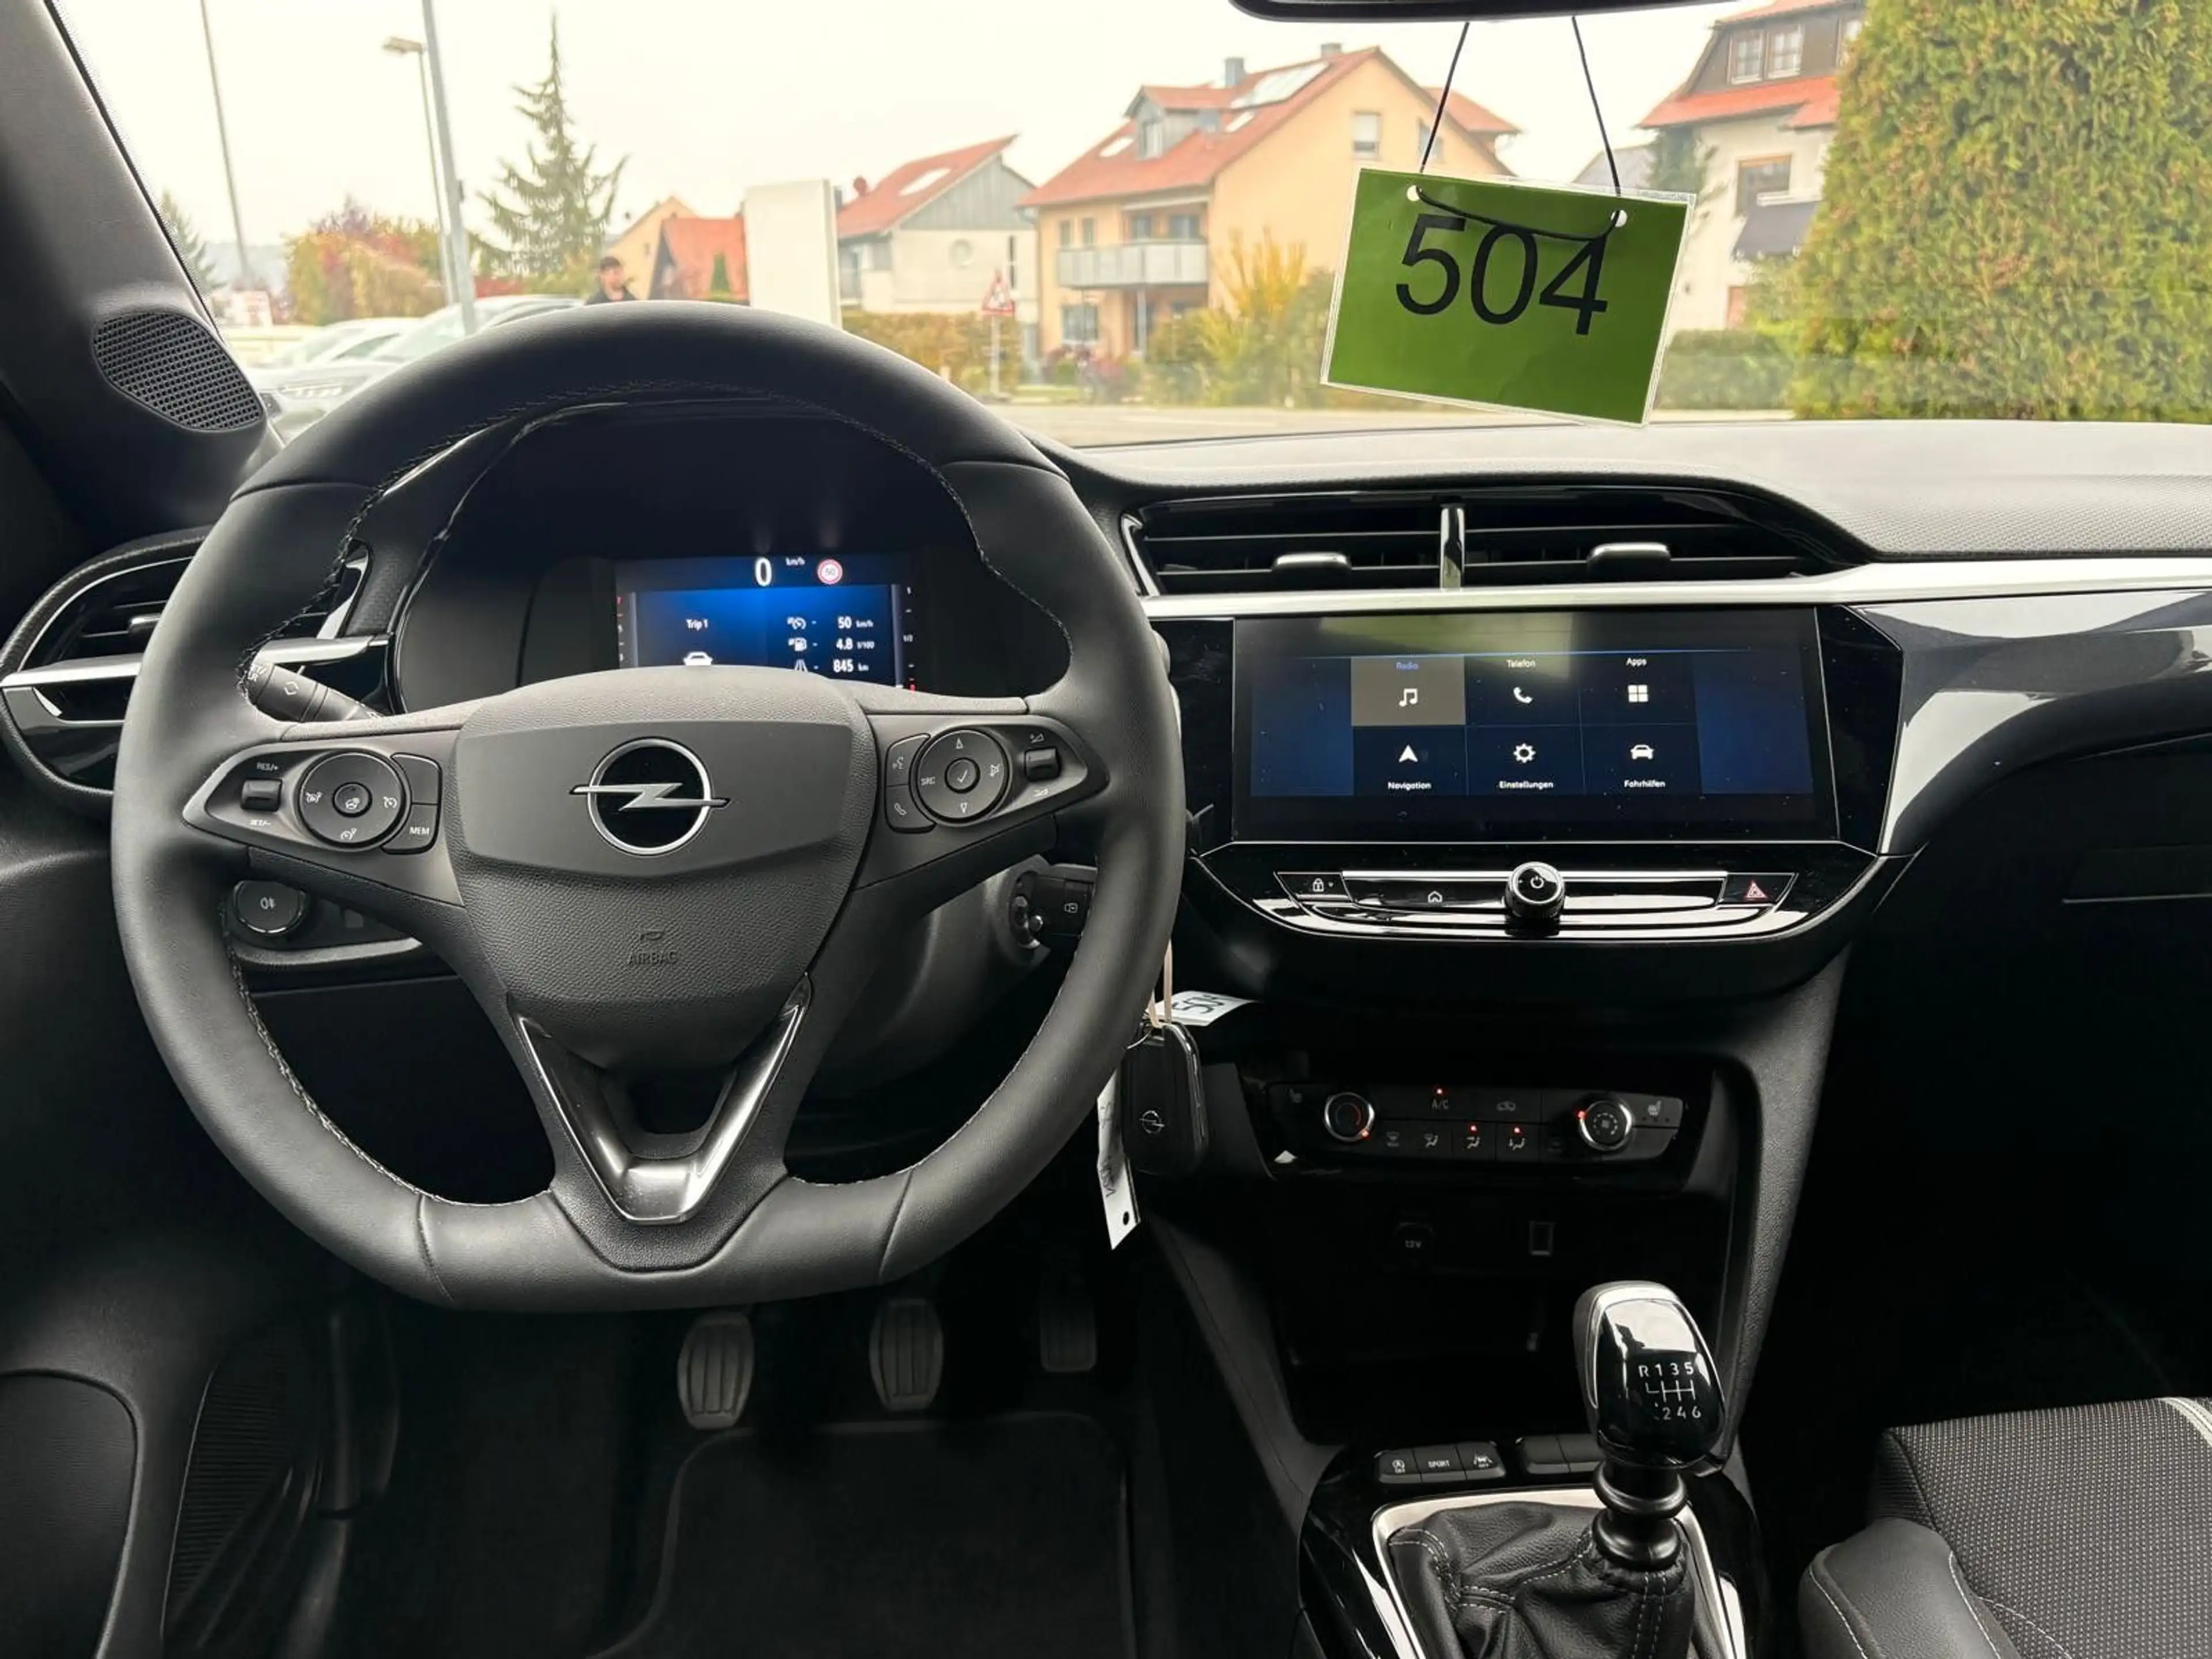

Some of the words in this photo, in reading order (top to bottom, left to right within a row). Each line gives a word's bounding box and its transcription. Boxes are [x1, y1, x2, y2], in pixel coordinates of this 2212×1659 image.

[1396, 213, 1608, 335] 504
[755, 557, 772, 586] 0
[686, 619, 703, 631] Trip
[703, 619, 708, 628] 1
[838, 616, 852, 628] 50
[836, 637, 853, 650] 4.8
[833, 658, 854, 673] 845
[1396, 661, 1418, 670] Radio
[1506, 659, 1536, 668] Telefon
[1626, 657, 1647, 666] Apps
[1388, 781, 1432, 790] Navigation
[1499, 781, 1554, 790] Einstellungen
[1624, 779, 1666, 788] Fahrhilfen
[410, 827, 430, 835] MEM
[1431, 1099, 1450, 1111] A/C
[1638, 1365, 1649, 1377] R
[1654, 1363, 1662, 1376] 1
[1670, 1363, 1680, 1376] 3
[1684, 1361, 1694, 1374] 5
[1662, 1407, 1671, 1421] 2
[1676, 1406, 1687, 1419] 4
[1691, 1406, 1702, 1418] 6
[1428, 1460, 1450, 1468] SPORT
